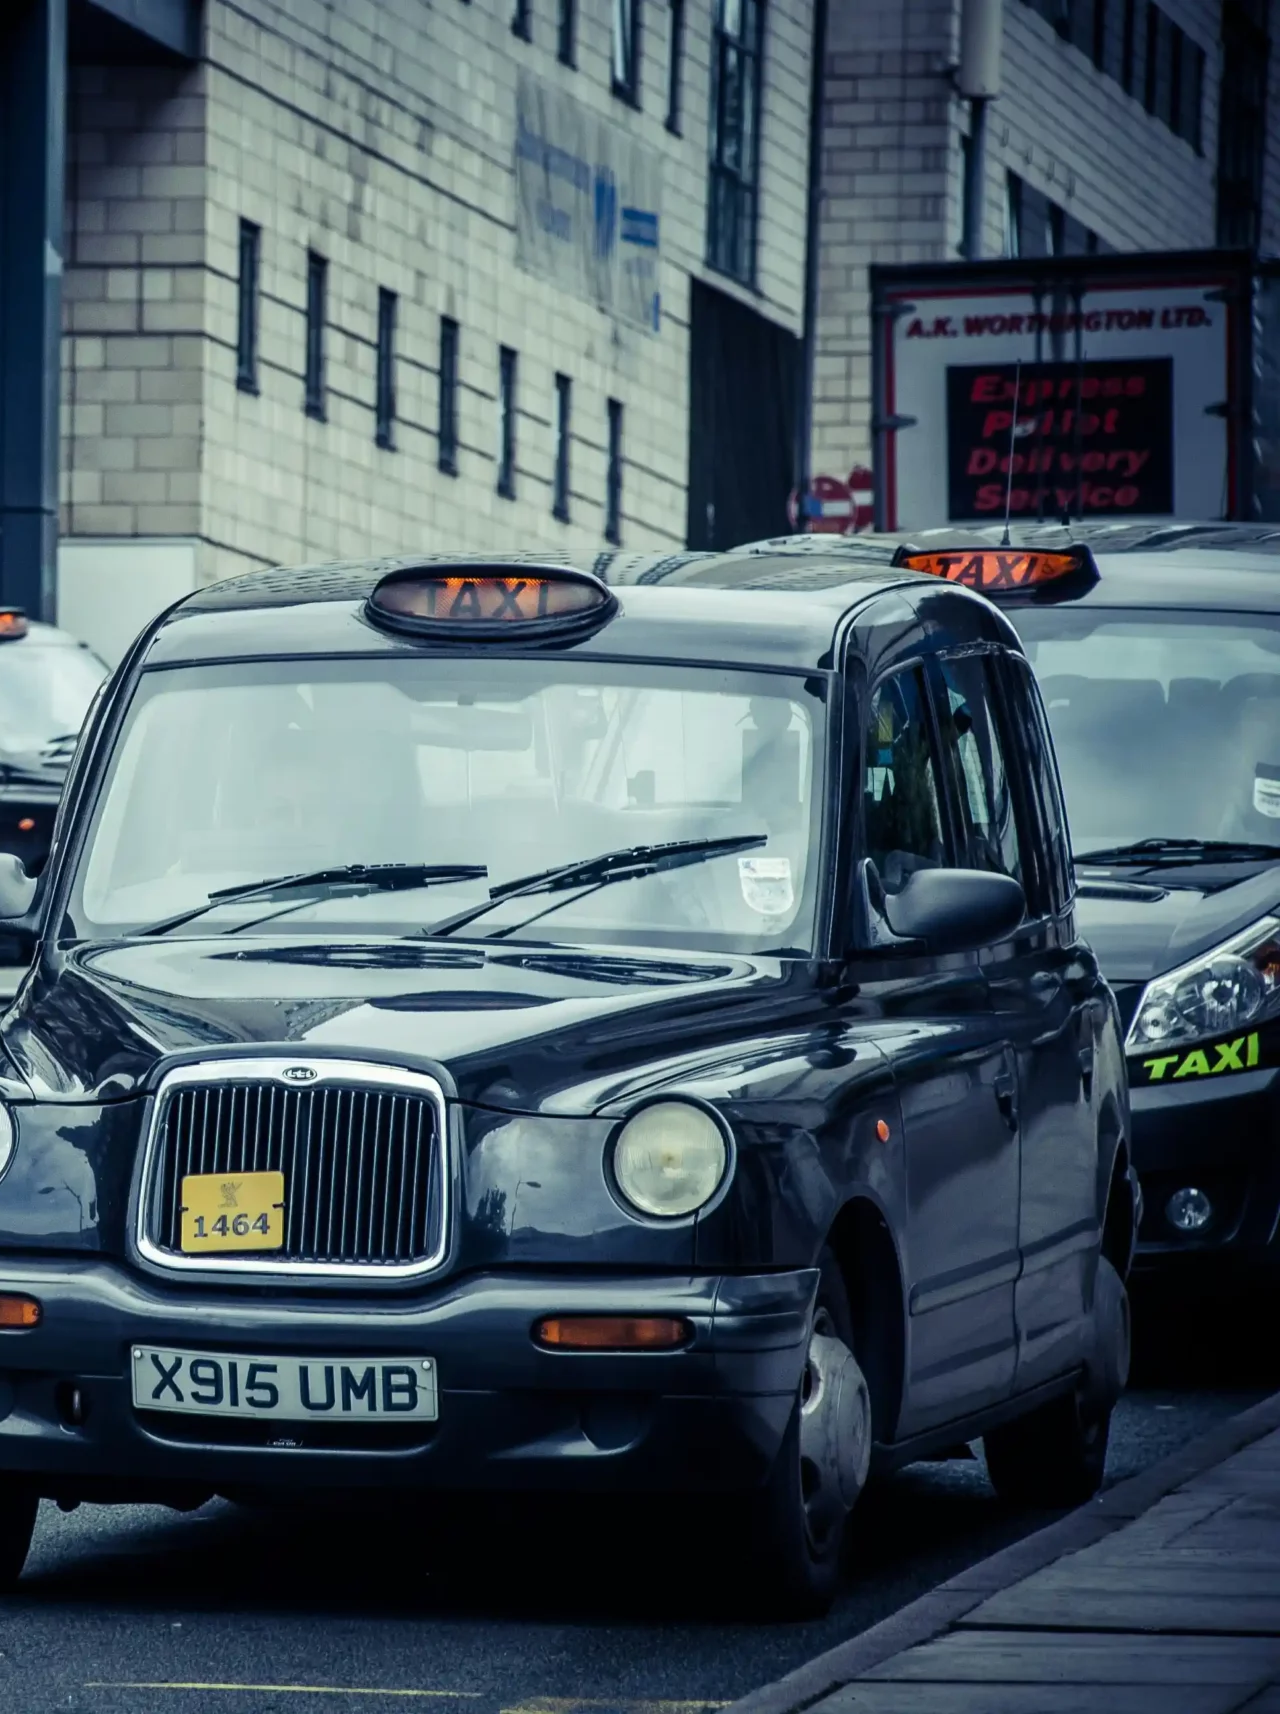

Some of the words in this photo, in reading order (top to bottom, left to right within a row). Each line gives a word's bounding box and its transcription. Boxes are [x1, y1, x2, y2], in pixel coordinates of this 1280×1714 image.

[906, 316, 958, 339] A.K.
[963, 309, 1154, 338] WORTNGTON
[1161, 306, 1213, 329] LTD.
[971, 375, 1145, 405] Express
[967, 447, 1149, 476] Delivery
[975, 484, 1139, 510] Service
[936, 555, 1039, 588] TAXI
[422, 580, 549, 618] TAXI
[1143, 1032, 1259, 1080] TAXI
[194, 1213, 270, 1238] 1464
[151, 1354, 279, 1409] X915
[299, 1365, 418, 1412] UMB
